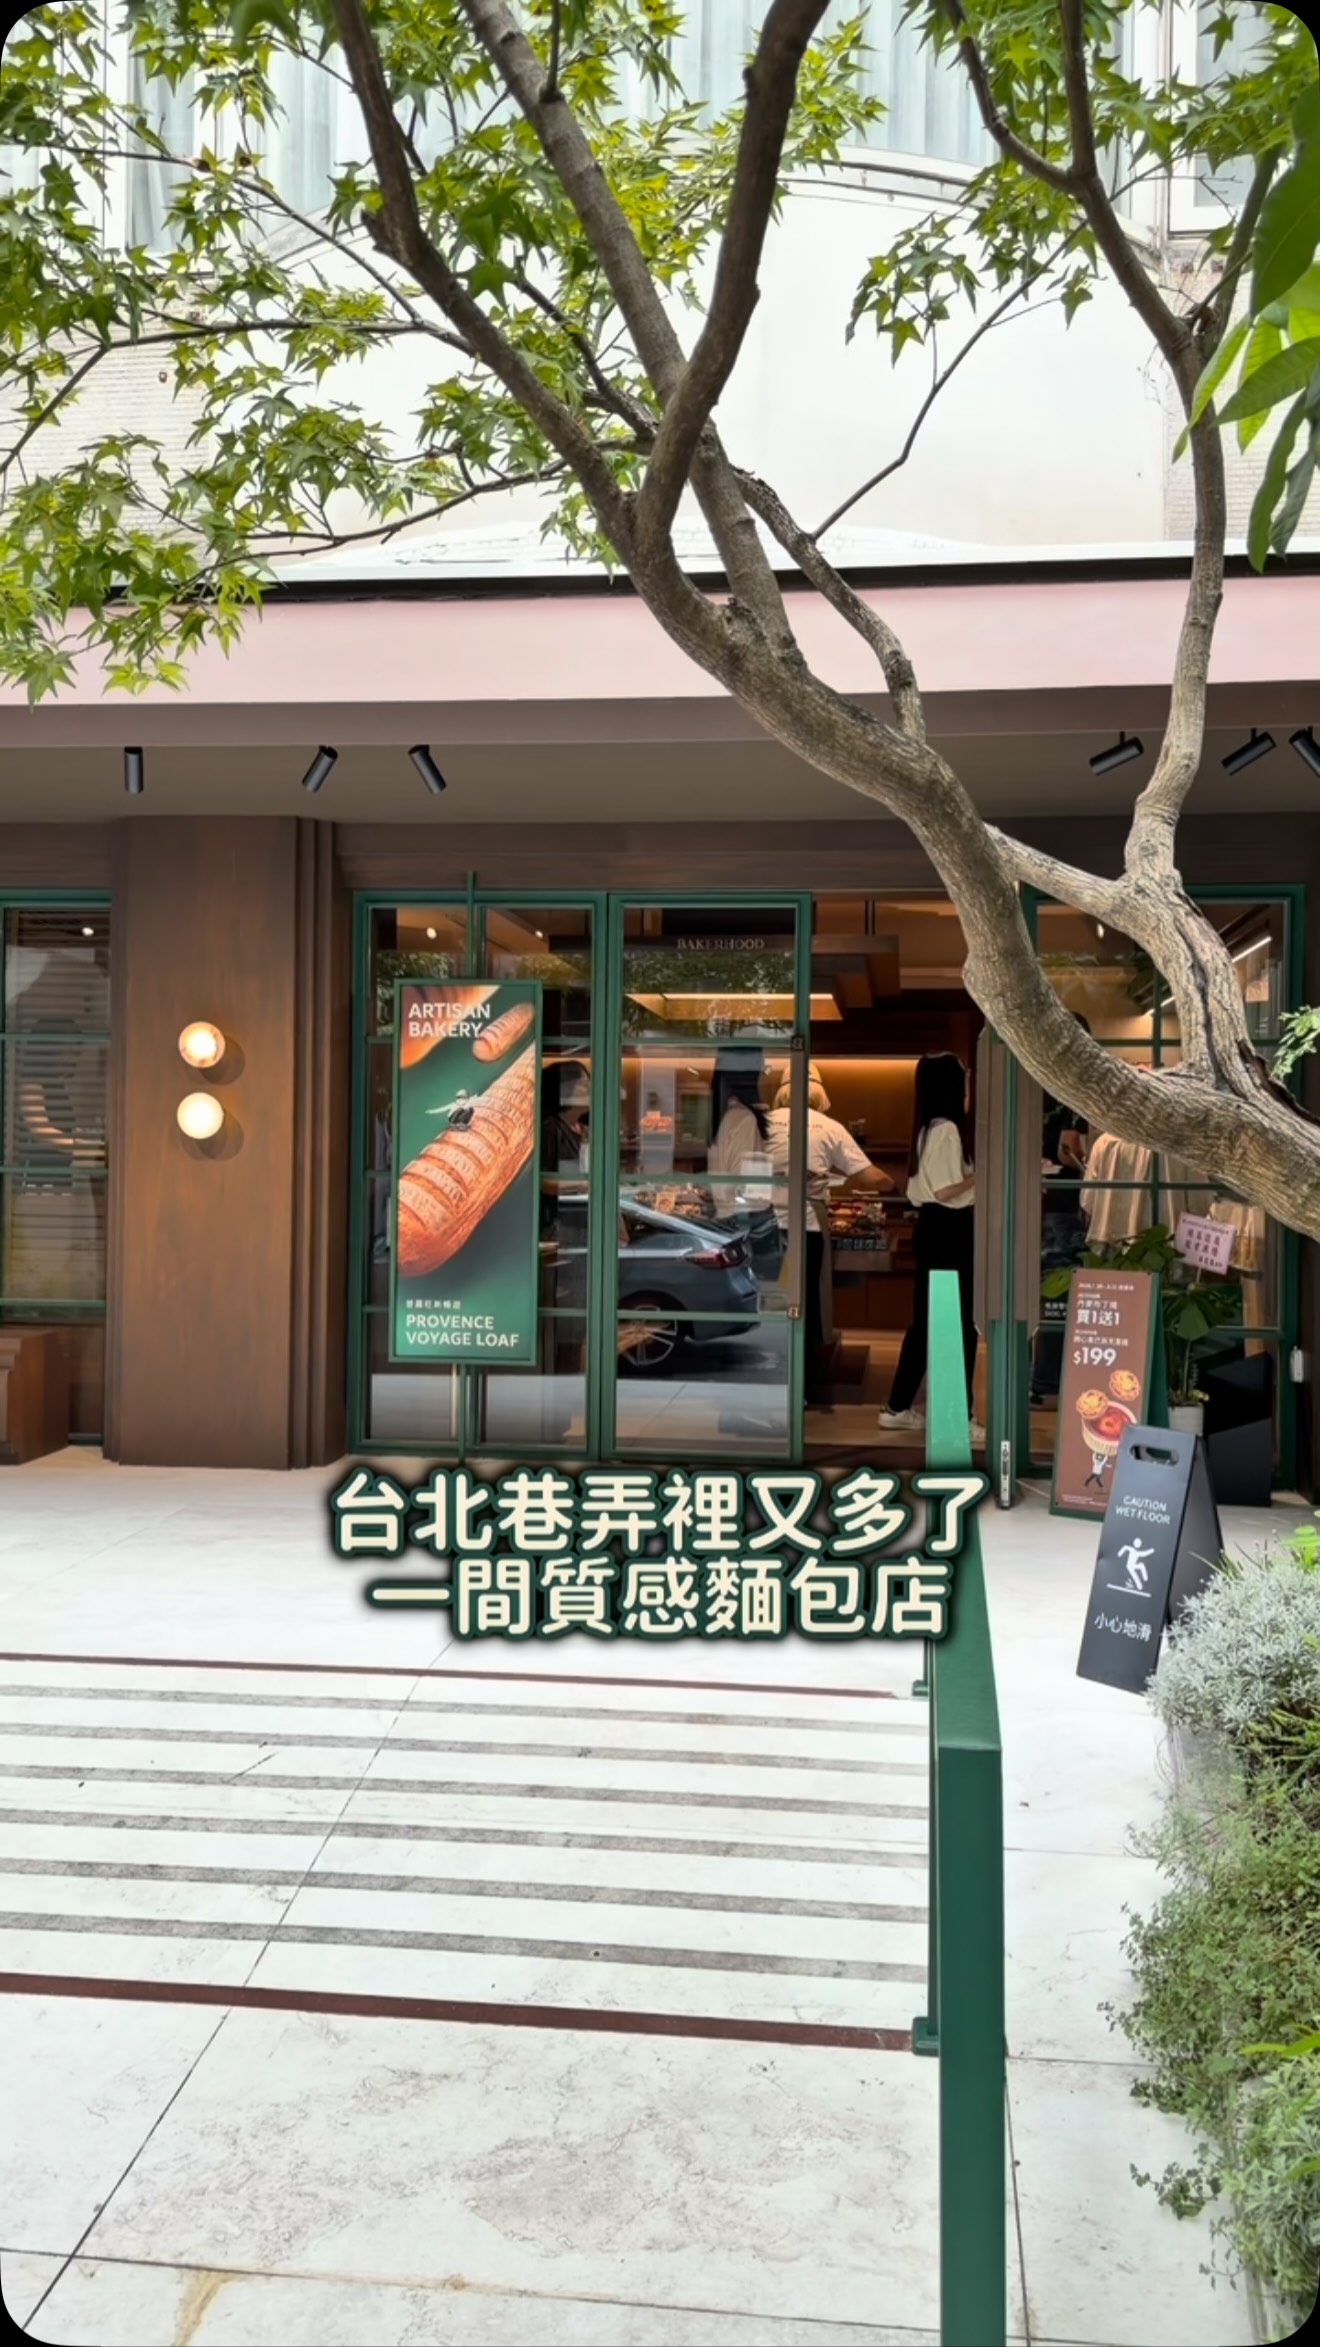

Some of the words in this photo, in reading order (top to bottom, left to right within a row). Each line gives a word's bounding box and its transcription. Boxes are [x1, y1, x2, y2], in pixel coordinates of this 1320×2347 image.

[408, 1002, 491, 1019] ARTISAN
[408, 1021, 483, 1038] BAKERY
[406, 1314, 495, 1330] PROVENCE
[1076, 1309, 1120, 1327] 買1送1
[405, 1331, 472, 1346] VOYAGE
[476, 1333, 519, 1348] LOAF
[1073, 1346, 1117, 1367] $199
[1122, 1495, 1168, 1513] CAUTION
[1115, 1505, 1137, 1519] WET
[1137, 1509, 1171, 1525] FLOOR
[1094, 1612, 1152, 1643] 小心地滑
